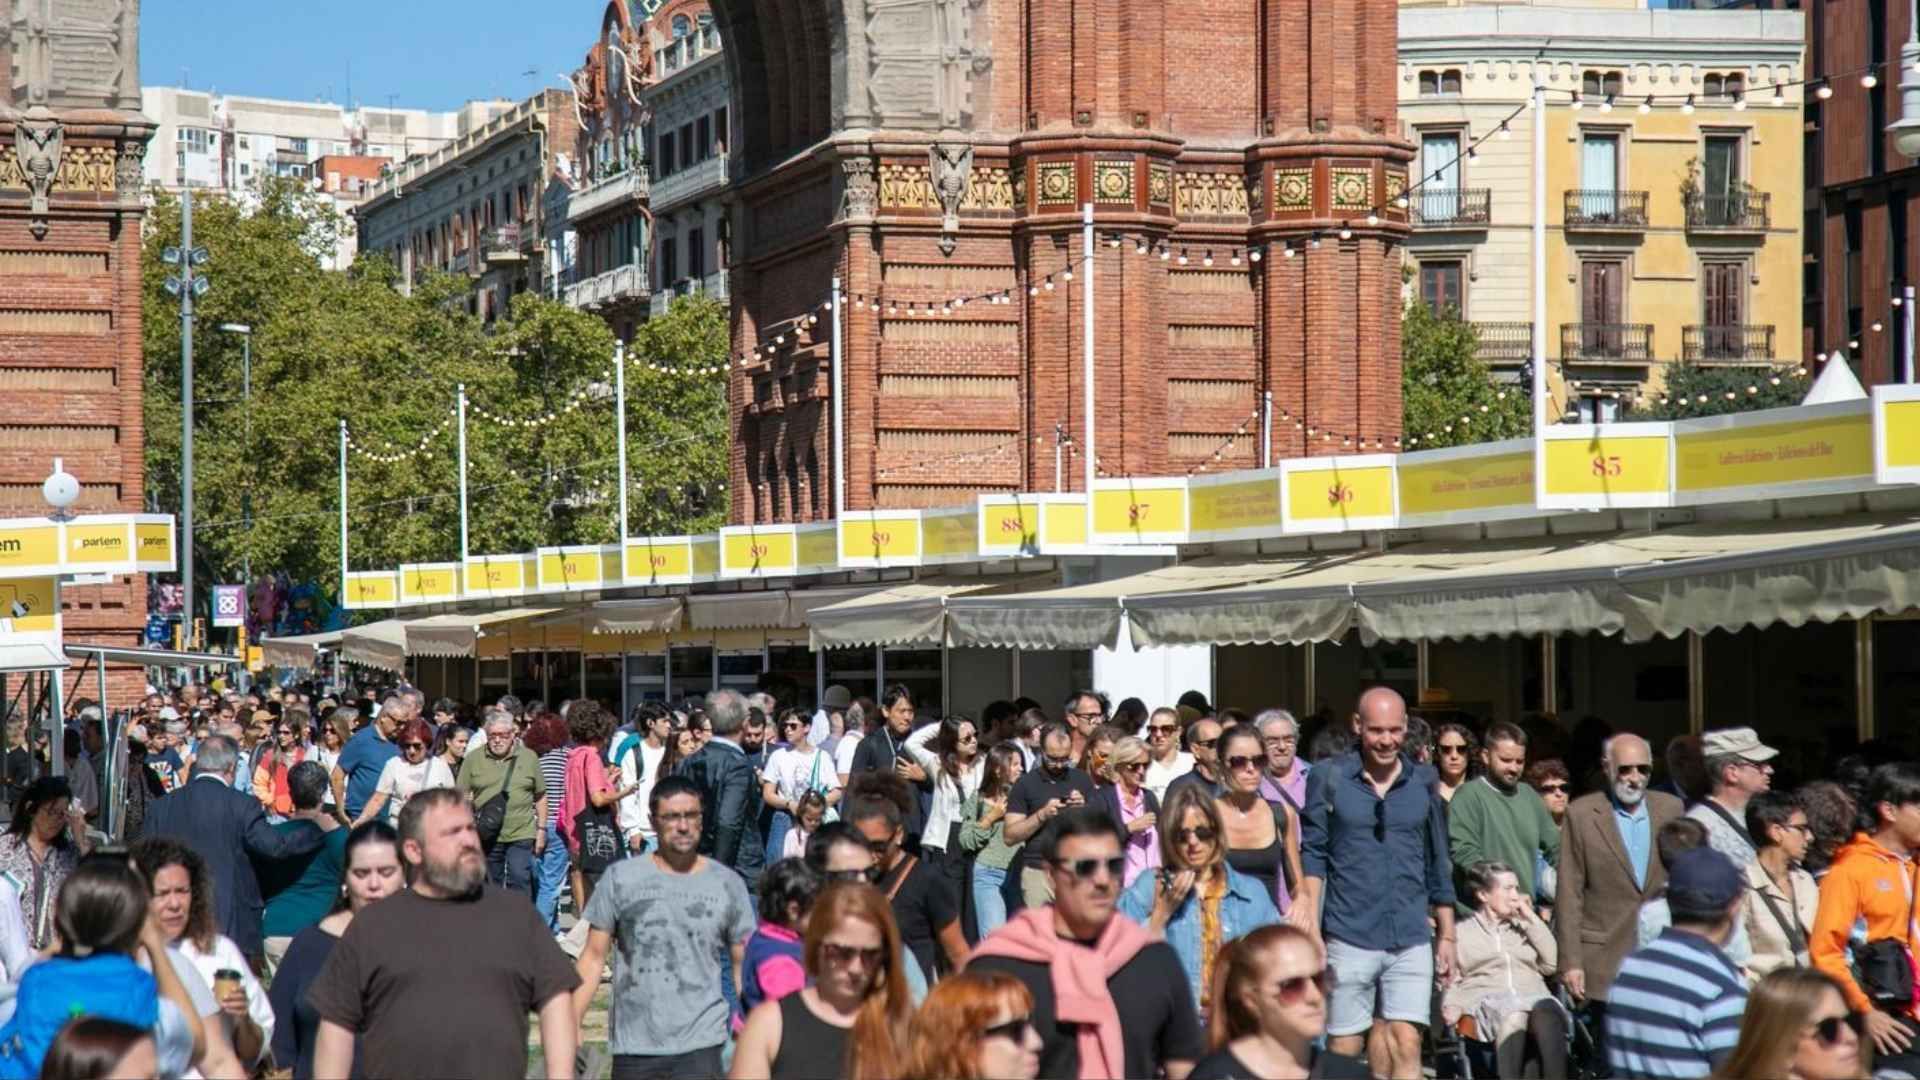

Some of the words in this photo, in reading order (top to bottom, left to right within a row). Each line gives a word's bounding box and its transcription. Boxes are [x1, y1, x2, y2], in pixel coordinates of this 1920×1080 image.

[1592, 457, 1622, 477] 85
[1328, 486, 1353, 503] 86
[1129, 504, 1150, 521] 87
[1002, 518, 1022, 532] 88
[0, 539, 21, 551] m
[82, 537, 122, 548] parlem
[873, 532, 890, 545] 89
[751, 545, 768, 557] 89
[650, 554, 667, 567] 90
[564, 563, 576, 575] 91
